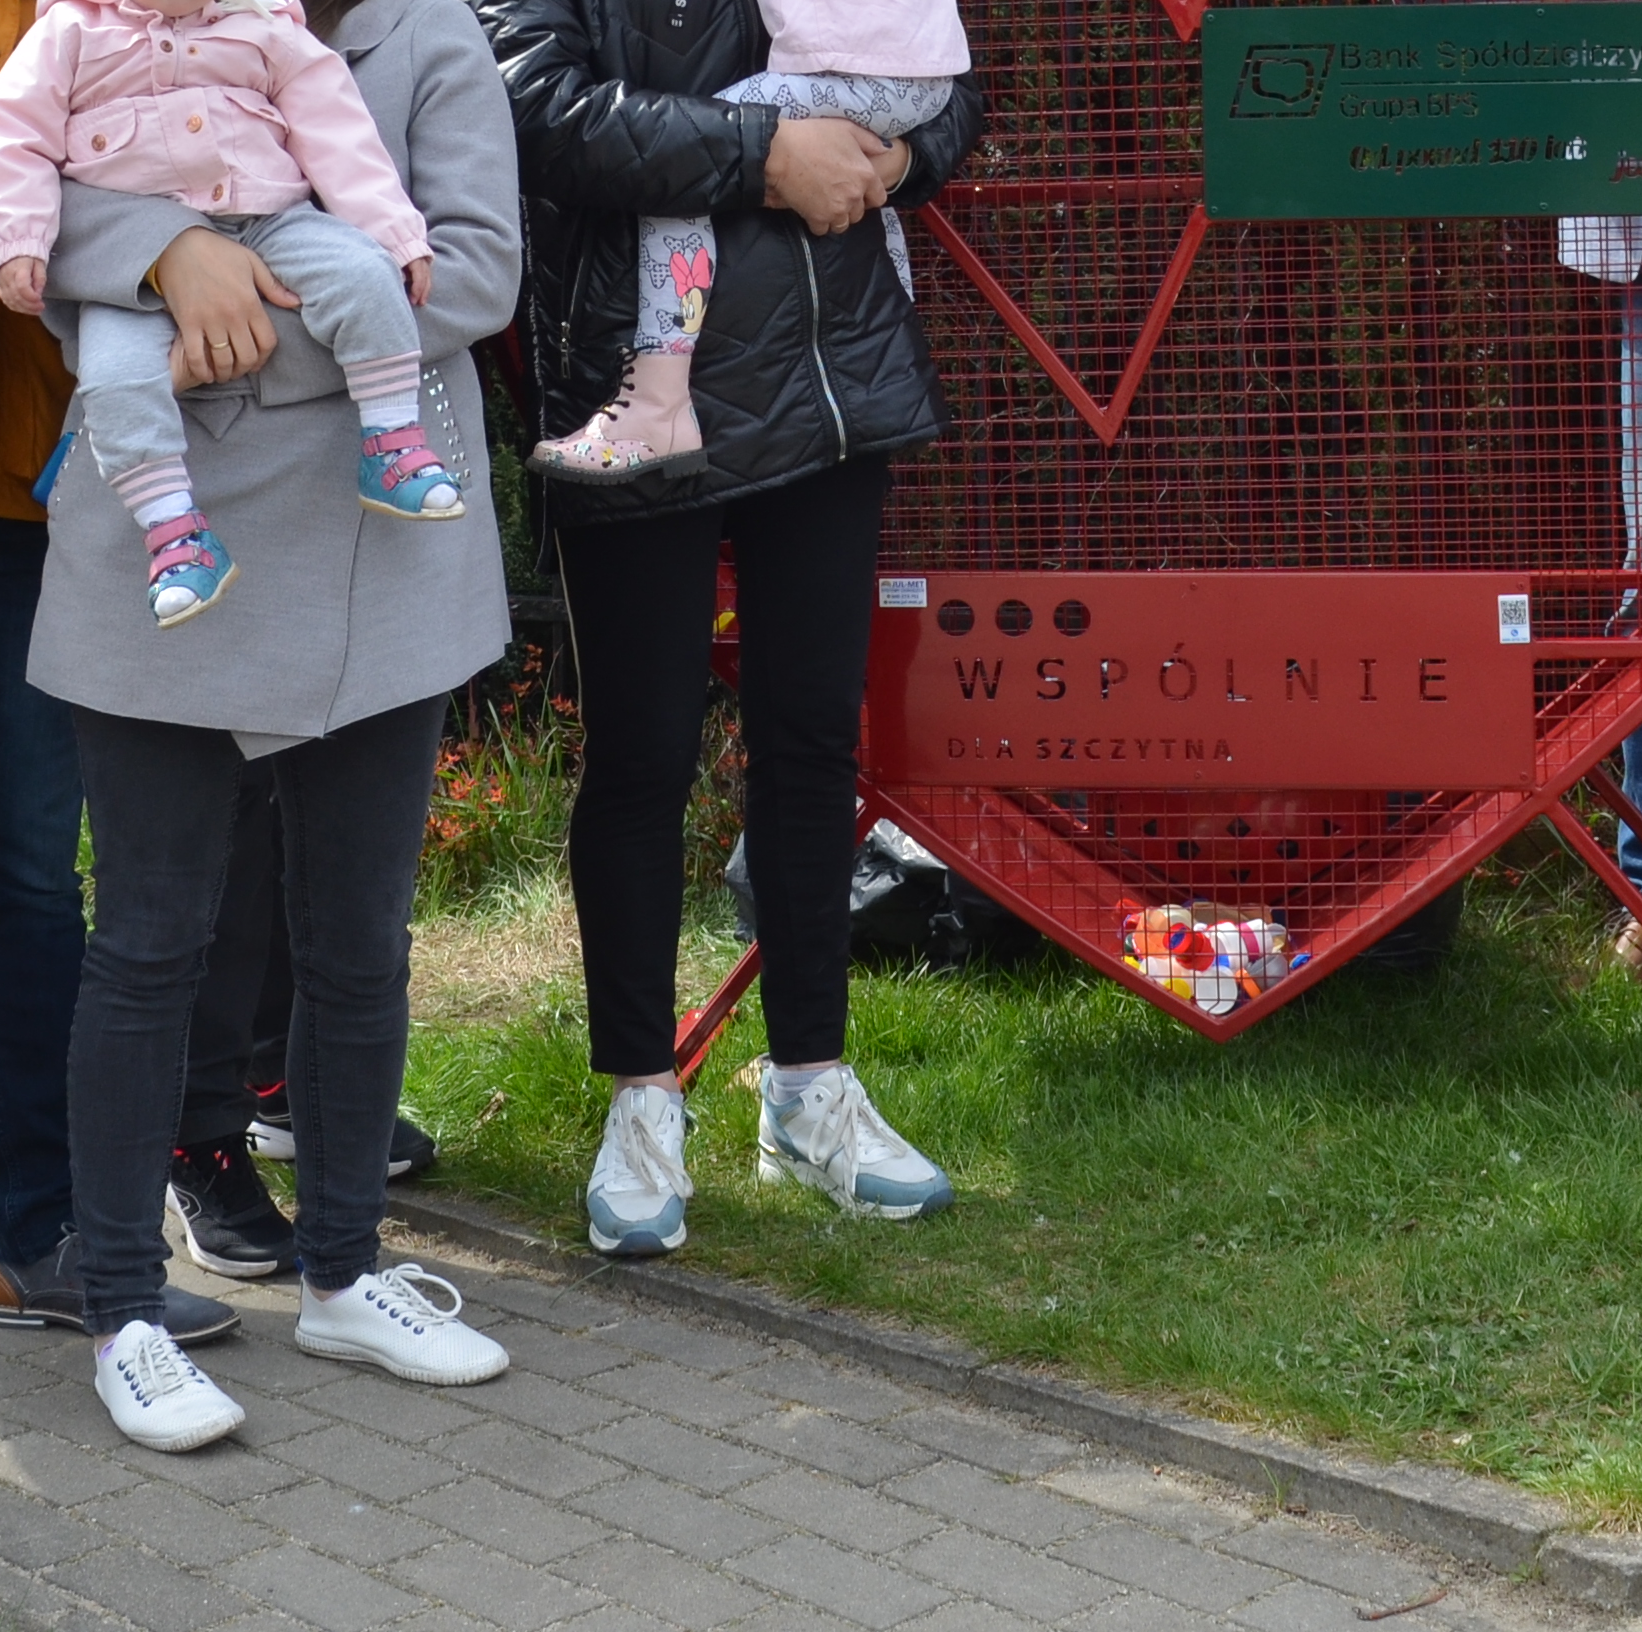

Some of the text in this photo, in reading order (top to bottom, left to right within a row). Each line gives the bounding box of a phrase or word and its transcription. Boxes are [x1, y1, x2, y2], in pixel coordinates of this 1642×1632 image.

[1340, 42, 1420, 70] Bank
[1339, 91, 1479, 124] Grupa BPS
[1393, 138, 1481, 175] ponad
[1487, 137, 1539, 165] 110
[954, 642, 1447, 703] WSPÓLNIE
[948, 737, 1233, 762] DLA SZCZYTNA
